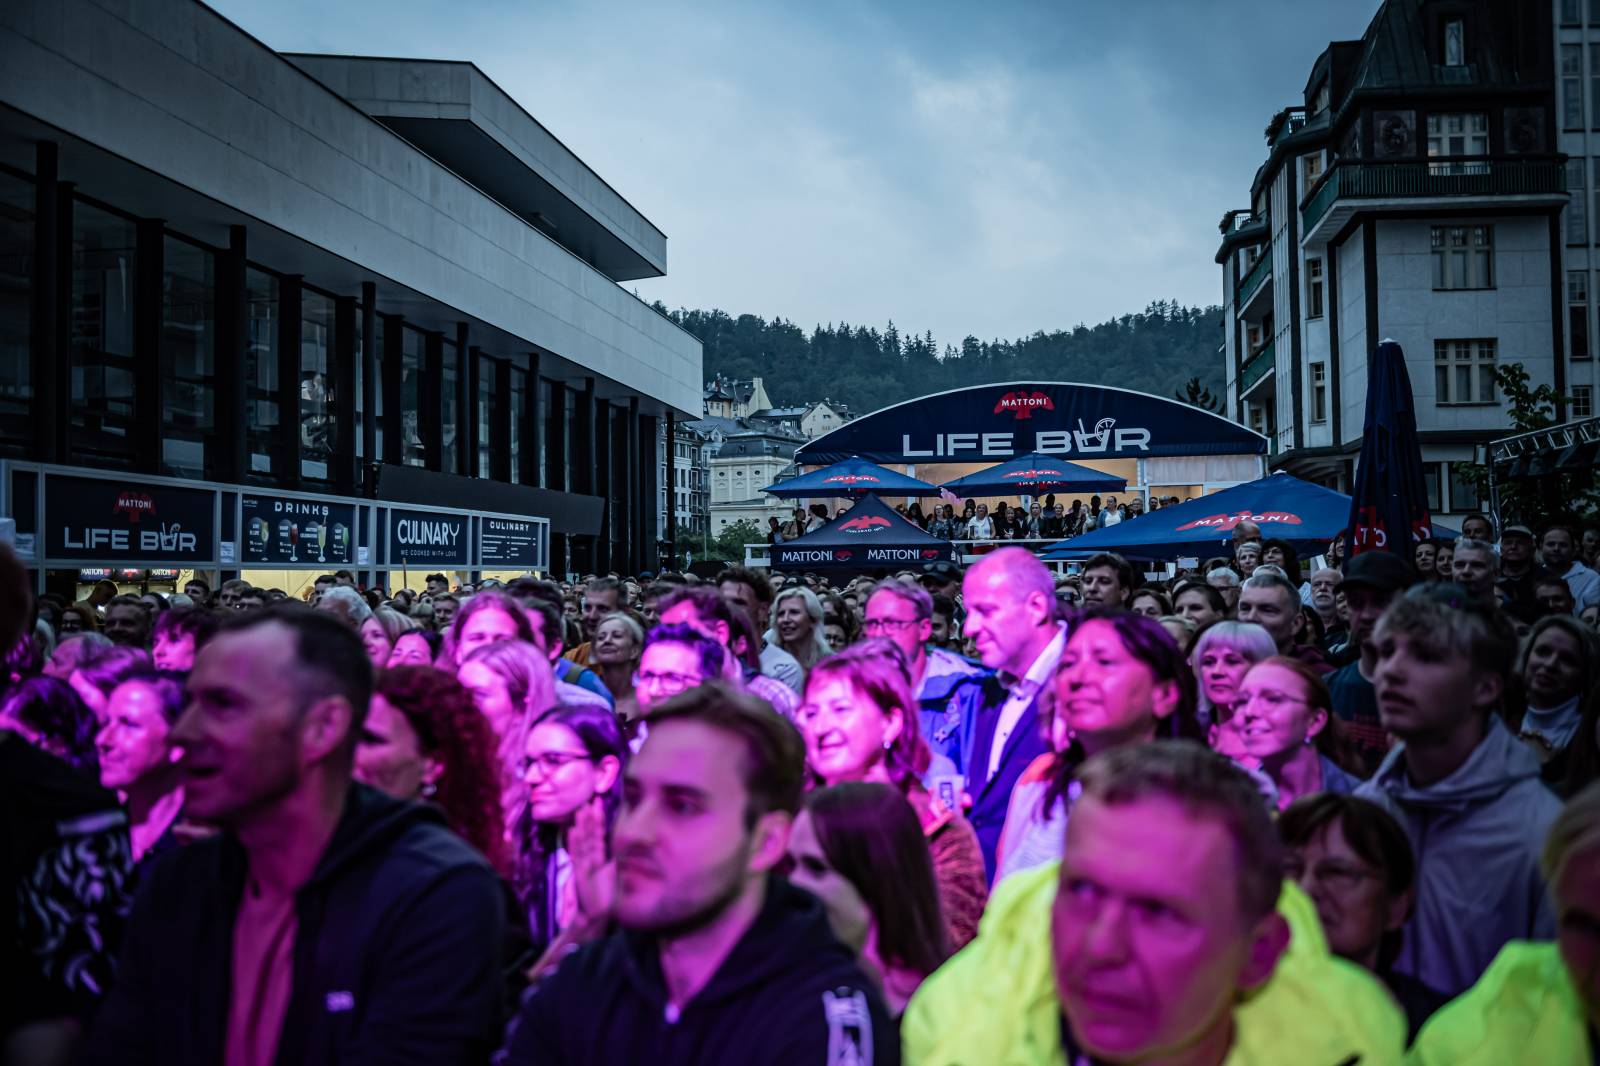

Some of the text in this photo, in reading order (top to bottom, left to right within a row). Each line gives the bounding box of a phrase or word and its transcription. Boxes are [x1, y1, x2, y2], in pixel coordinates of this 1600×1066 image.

[1001, 398, 1047, 407] MATTONI
[902, 432, 1014, 457] LIFE
[118, 497, 152, 509] MATTONI
[274, 501, 329, 515] DRINKS
[489, 520, 530, 532] CULINARY
[1195, 515, 1289, 526] MATTONI
[64, 526, 130, 550] LIFE
[397, 519, 460, 546] CULINARY
[781, 549, 833, 562] MATTONI
[868, 548, 920, 561] MATTONI
